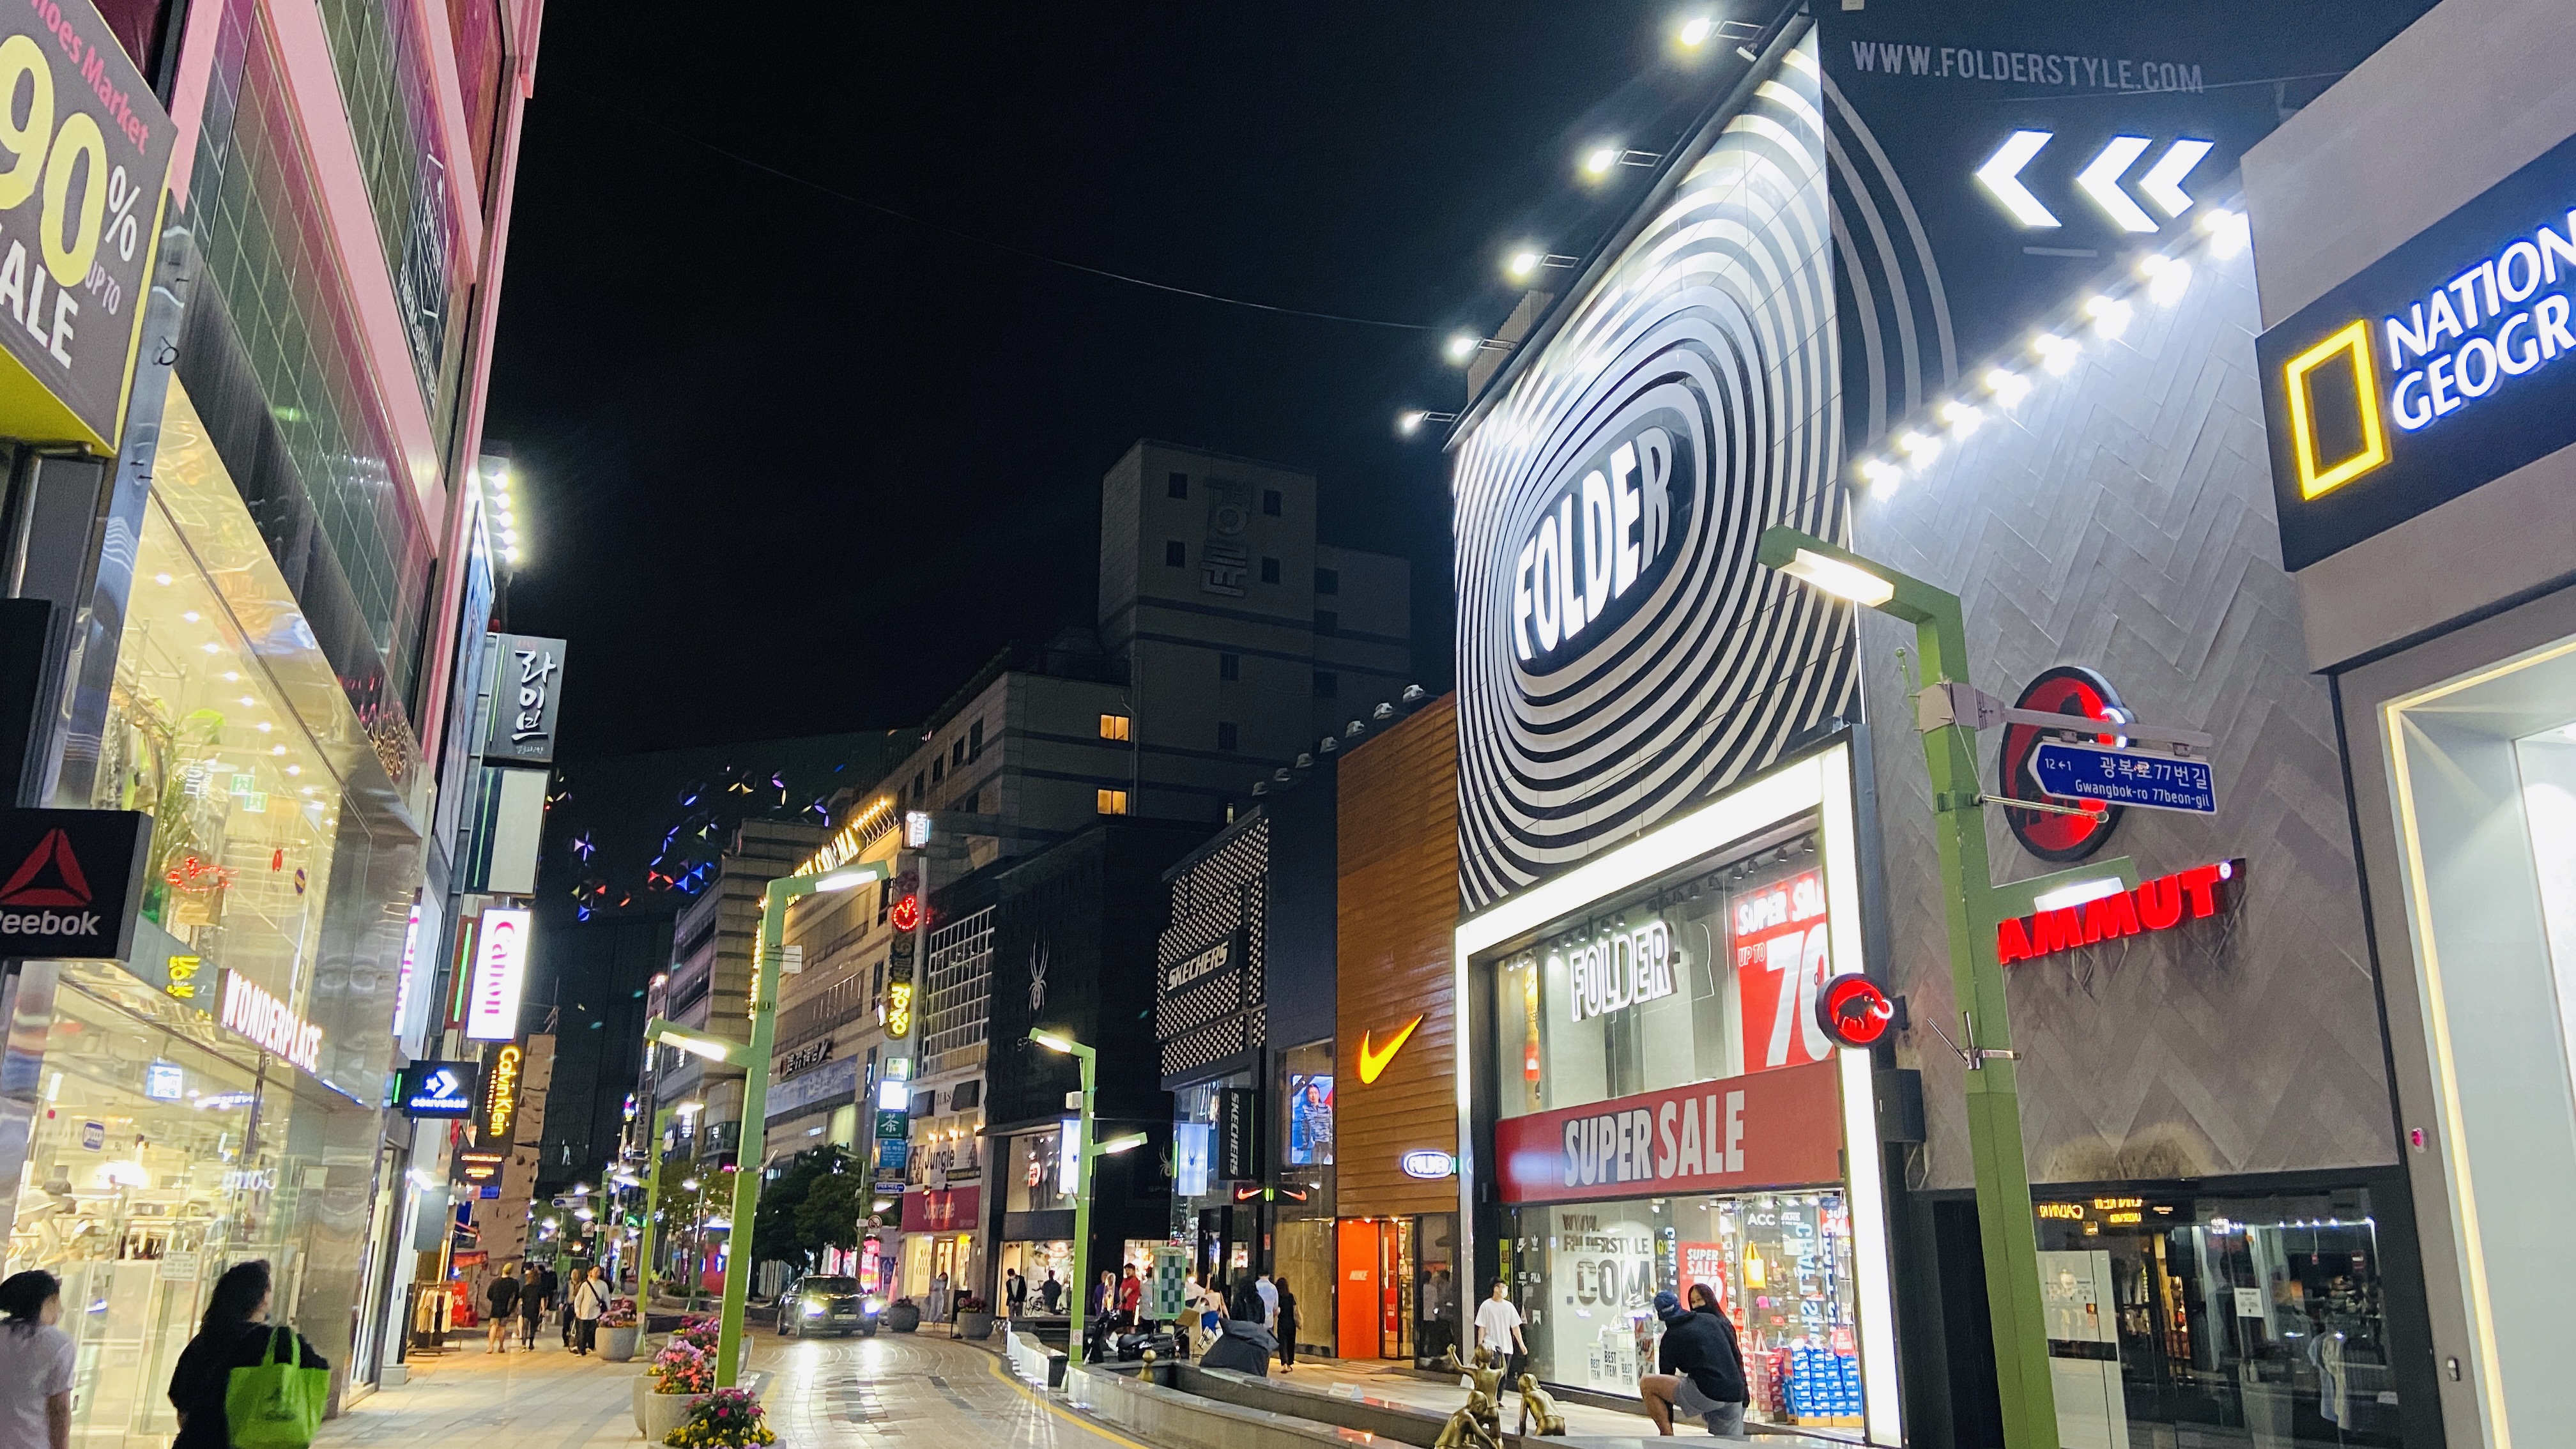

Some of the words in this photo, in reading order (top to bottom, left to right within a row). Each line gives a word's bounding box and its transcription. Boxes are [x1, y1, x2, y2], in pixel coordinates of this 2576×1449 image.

[1851, 41, 2204, 93] WWW.FOLDERSTYLE.COM
[81, 45, 149, 155] Market
[84, 261, 105, 295] UP
[102, 275, 121, 315] TO
[0, 239, 79, 369] ALE
[1514, 426, 1673, 661] FOLDER
[2044, 758, 2055, 769] 12
[2076, 779, 2148, 799] Gwangbok-ro
[2152, 788, 2210, 809] 77beon-gil
[915, 813, 927, 848] HOTEL
[0, 910, 101, 935] eebok
[1738, 891, 1788, 936] SUPER
[1167, 940, 1229, 991] SKECHERS
[1738, 946, 1752, 967] UP
[1753, 942, 1766, 963] TO
[1569, 921, 1673, 1022] FOLDER
[496, 1048, 519, 1096] Calvin
[411, 1098, 468, 1108] CONVERSE
[490, 1098, 513, 1135] Klein
[880, 1113, 900, 1133] 茶
[1230, 1092, 1239, 1176] SKECHERS
[1565, 1108, 1653, 1187] SUPER
[1659, 1090, 1745, 1179] SALE
[924, 1147, 955, 1174] Jungle
[1409, 1155, 1451, 1173] FOLDER
[1747, 1213, 1775, 1225] ACC
[1563, 1233, 1649, 1254] FOLDERSTYLE
[1687, 1248, 1719, 1261] SUPER
[1349, 1270, 1369, 1281] NIKE
[1687, 1261, 1719, 1275] SALE
[1591, 1358, 1600, 1368] BEST
[1605, 1351, 1616, 1364] BEST
[1605, 1364, 1618, 1377] ITEM
[1621, 1363, 1632, 1374] BEST
